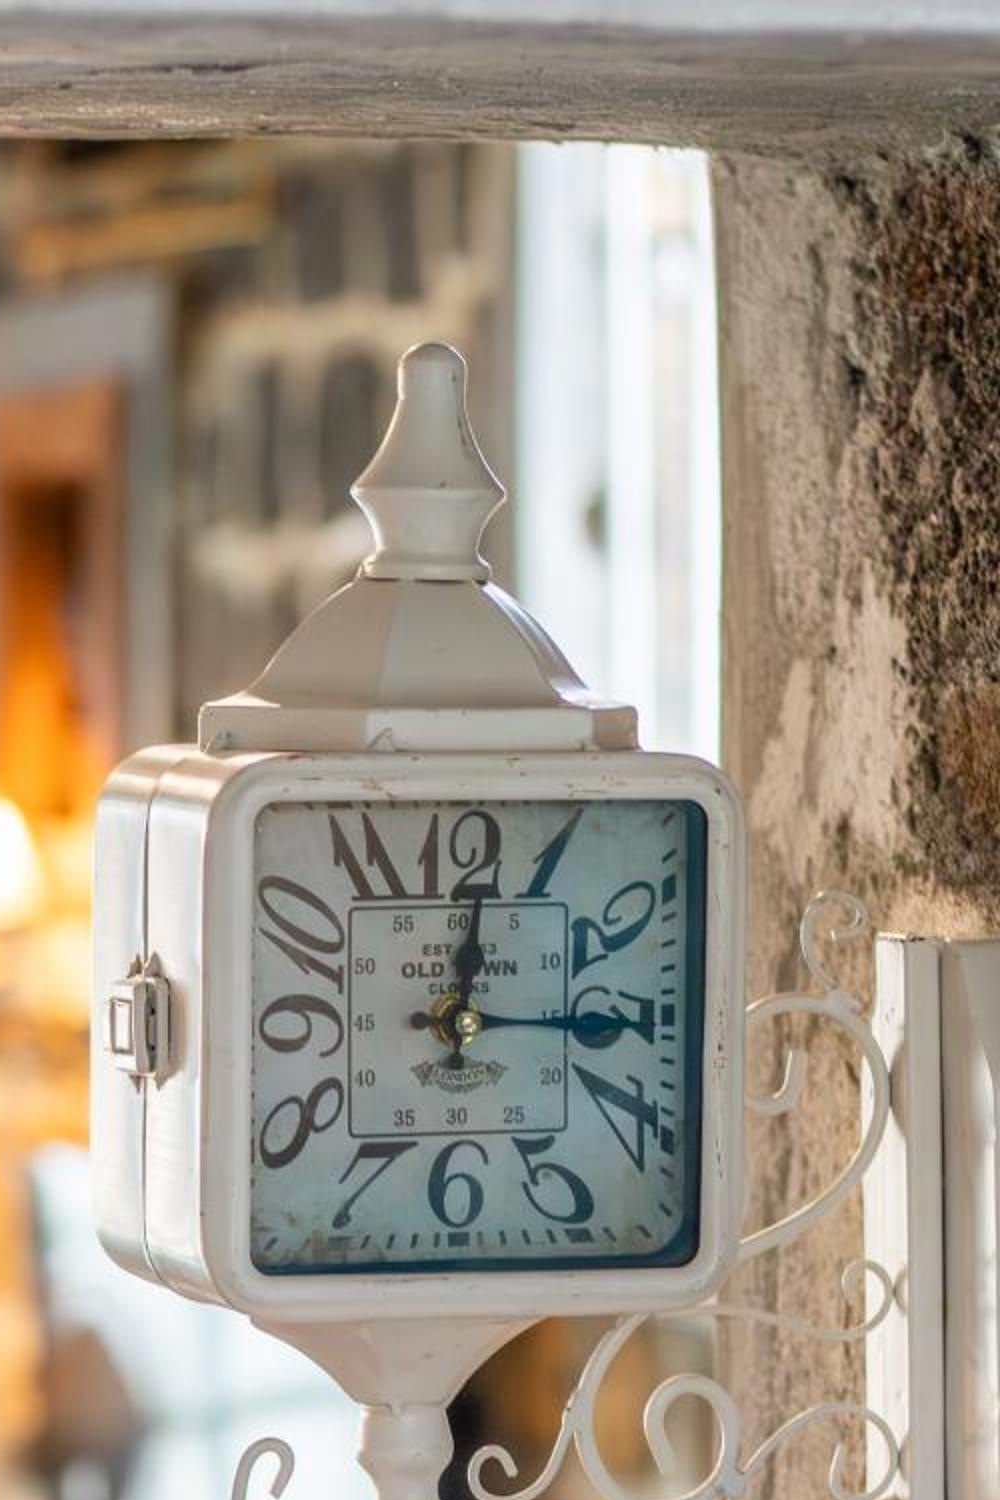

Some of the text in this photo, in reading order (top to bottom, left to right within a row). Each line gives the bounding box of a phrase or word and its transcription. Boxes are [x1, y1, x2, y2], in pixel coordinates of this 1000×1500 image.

[329, 812, 409, 900] 11
[417, 810, 502, 902] 12
[514, 809, 583, 898] 1
[393, 915, 415, 933] 55
[447, 913, 470, 931] 60
[509, 913, 520, 930] 5
[570, 880, 656, 980] 2
[258, 875, 345, 994] 10
[354, 958, 376, 976] 50
[401, 959, 518, 979] OLD WN
[540, 952, 561, 971] 10
[428, 981, 489, 995] CLOKS
[259, 994, 345, 1058] 9
[354, 1014, 376, 1033] 45
[570, 985, 655, 1050] 3
[354, 1069, 376, 1088] 40
[540, 1067, 562, 1085] 20
[259, 1076, 344, 1170] 8
[393, 1109, 416, 1127] 35
[446, 1107, 468, 1125] 30
[503, 1105, 525, 1124] 25
[571, 1062, 659, 1174] 4
[330, 1140, 419, 1230] 7
[427, 1138, 489, 1229] 6
[511, 1134, 595, 1225] 5
